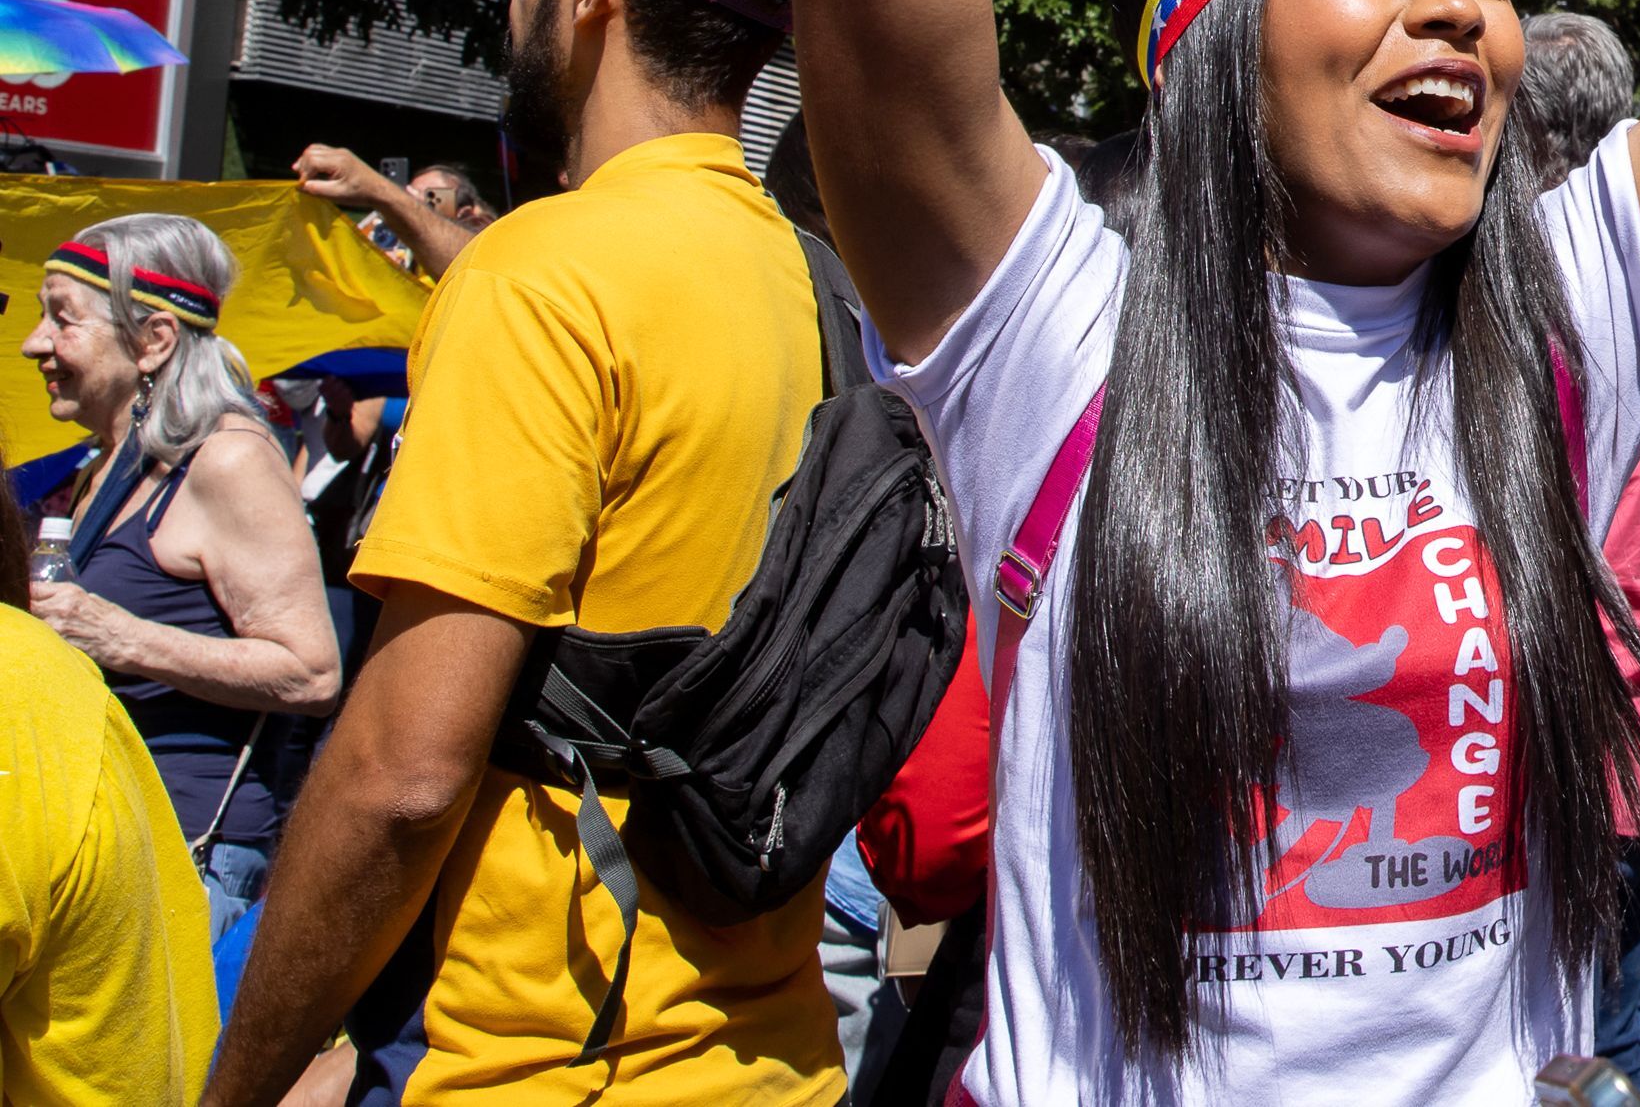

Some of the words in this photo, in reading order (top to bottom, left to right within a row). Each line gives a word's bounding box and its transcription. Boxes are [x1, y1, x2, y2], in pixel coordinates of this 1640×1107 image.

[1266, 477, 1325, 503] ET
[1266, 479, 1443, 565] MILE
[1422, 537, 1504, 834] CHANGE
[1364, 852, 1428, 889] THE
[1197, 948, 1366, 982] REVER
[1383, 917, 1512, 974] YOUNG
